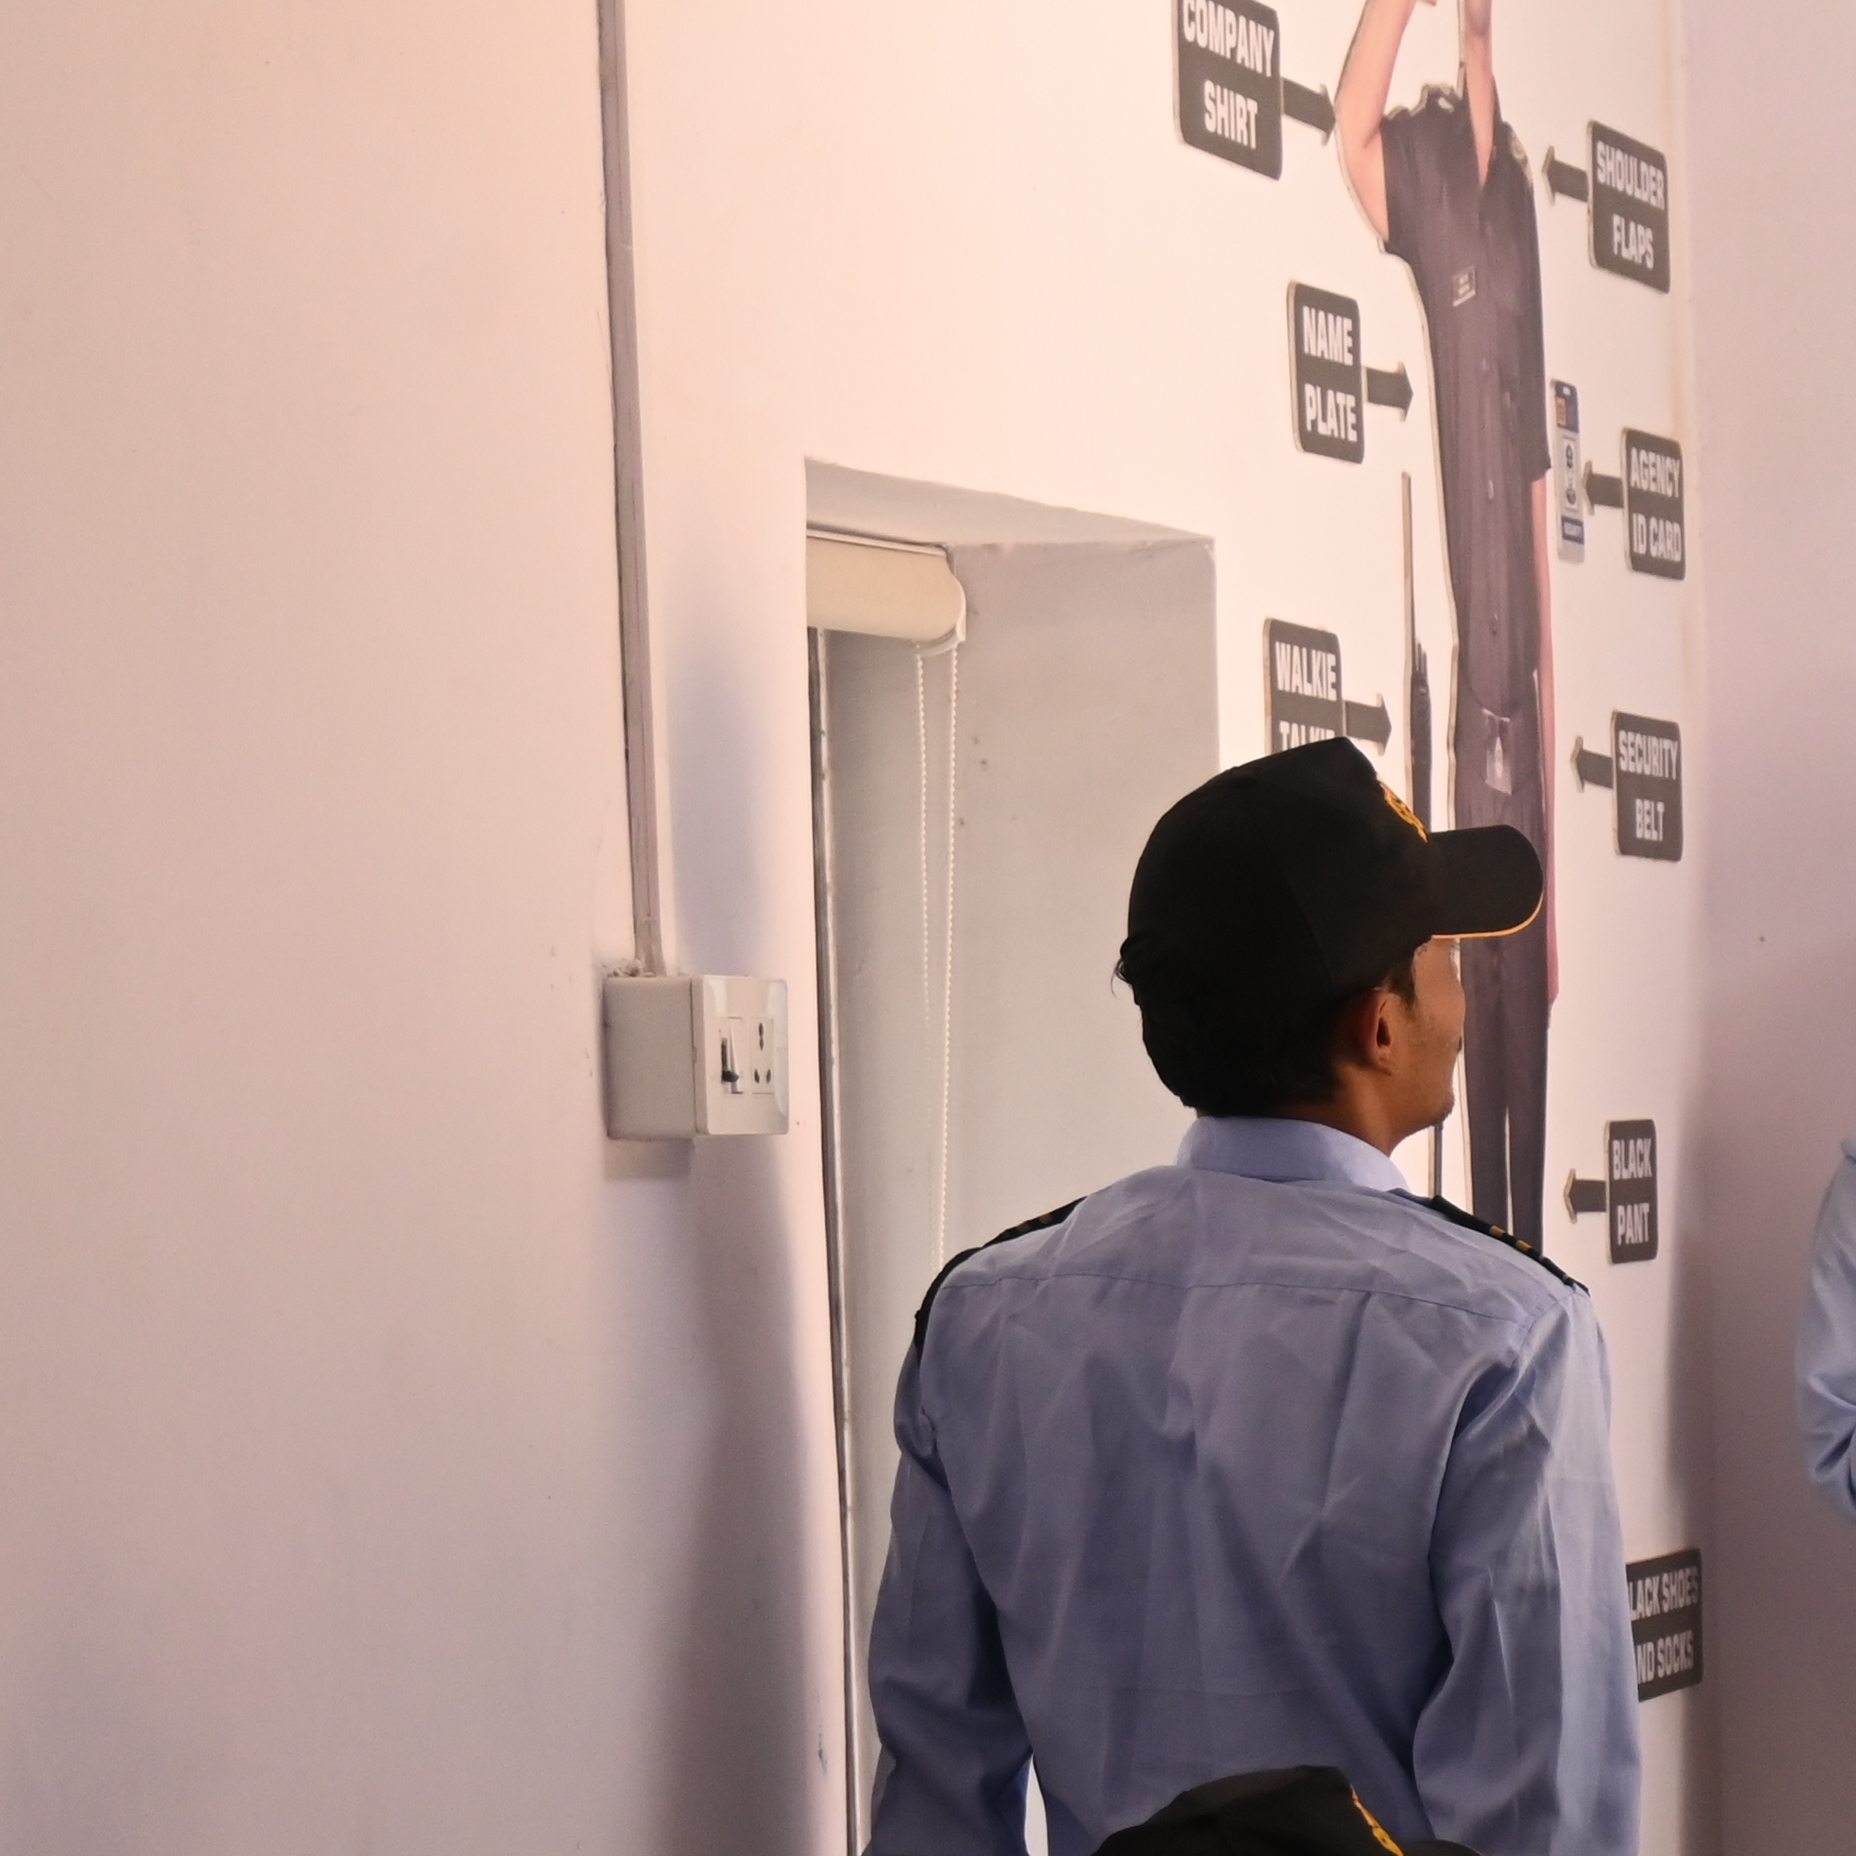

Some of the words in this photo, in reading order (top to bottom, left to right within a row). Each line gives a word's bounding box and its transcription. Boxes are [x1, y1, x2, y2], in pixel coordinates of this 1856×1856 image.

[1182, 0, 1275, 78] COMPANY
[1204, 79, 1259, 150] SHIRT
[1597, 139, 1666, 211] SHOULDER
[1612, 213, 1655, 271] FLAPS
[1302, 305, 1354, 367] NAME
[1304, 382, 1358, 443] PLATE
[1629, 446, 1682, 499] AGENCY
[1632, 512, 1648, 555] ID
[1650, 516, 1683, 562] CARD
[1274, 640, 1338, 702] WALKIE
[1618, 729, 1679, 781] SECURITY
[1635, 797, 1665, 842] BELT
[1612, 1137, 1653, 1181] BLACK
[1616, 1201, 1651, 1246] PANT
[1628, 1574, 1661, 1622] LACK
[1661, 1564, 1699, 1614] SHOES
[1637, 1640, 1656, 1685] ND
[1656, 1629, 1695, 1679] SOCKS
